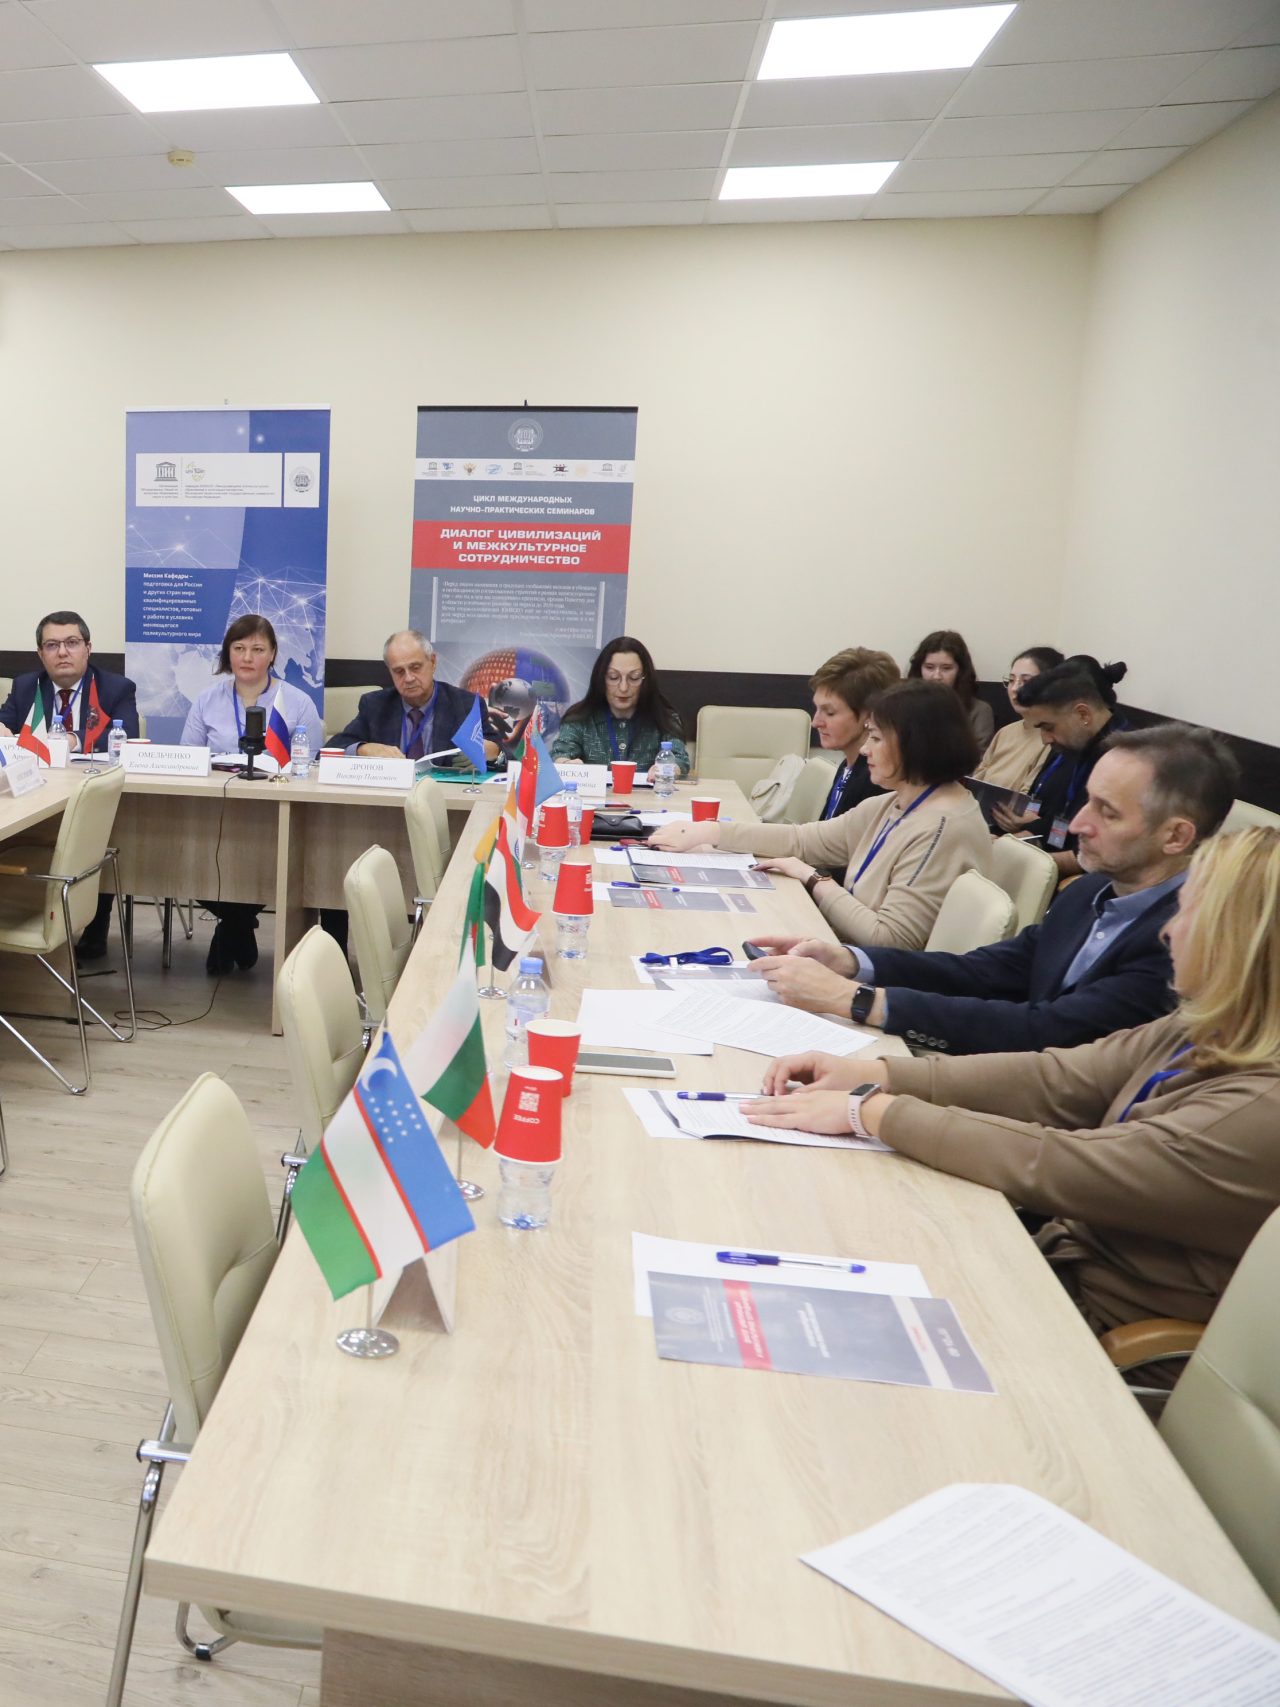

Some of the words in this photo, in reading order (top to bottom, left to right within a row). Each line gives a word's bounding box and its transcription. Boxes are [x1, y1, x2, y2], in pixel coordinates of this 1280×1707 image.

[473, 495, 496, 503] ЦИКЛ
[497, 495, 572, 504] МЕЖДУНАРОДНЫХ
[547, 508, 595, 516] СЕМИНАРОВ
[440, 528, 494, 539] ДИАЛОГ
[498, 529, 602, 541] ЦИВИЛИЗАЦИЙ
[453, 541, 463, 550] И
[466, 541, 587, 553] МЕЖКУЛЬТУРНОЕ
[458, 553, 580, 565] СОТРУДНИЧЕСТВО
